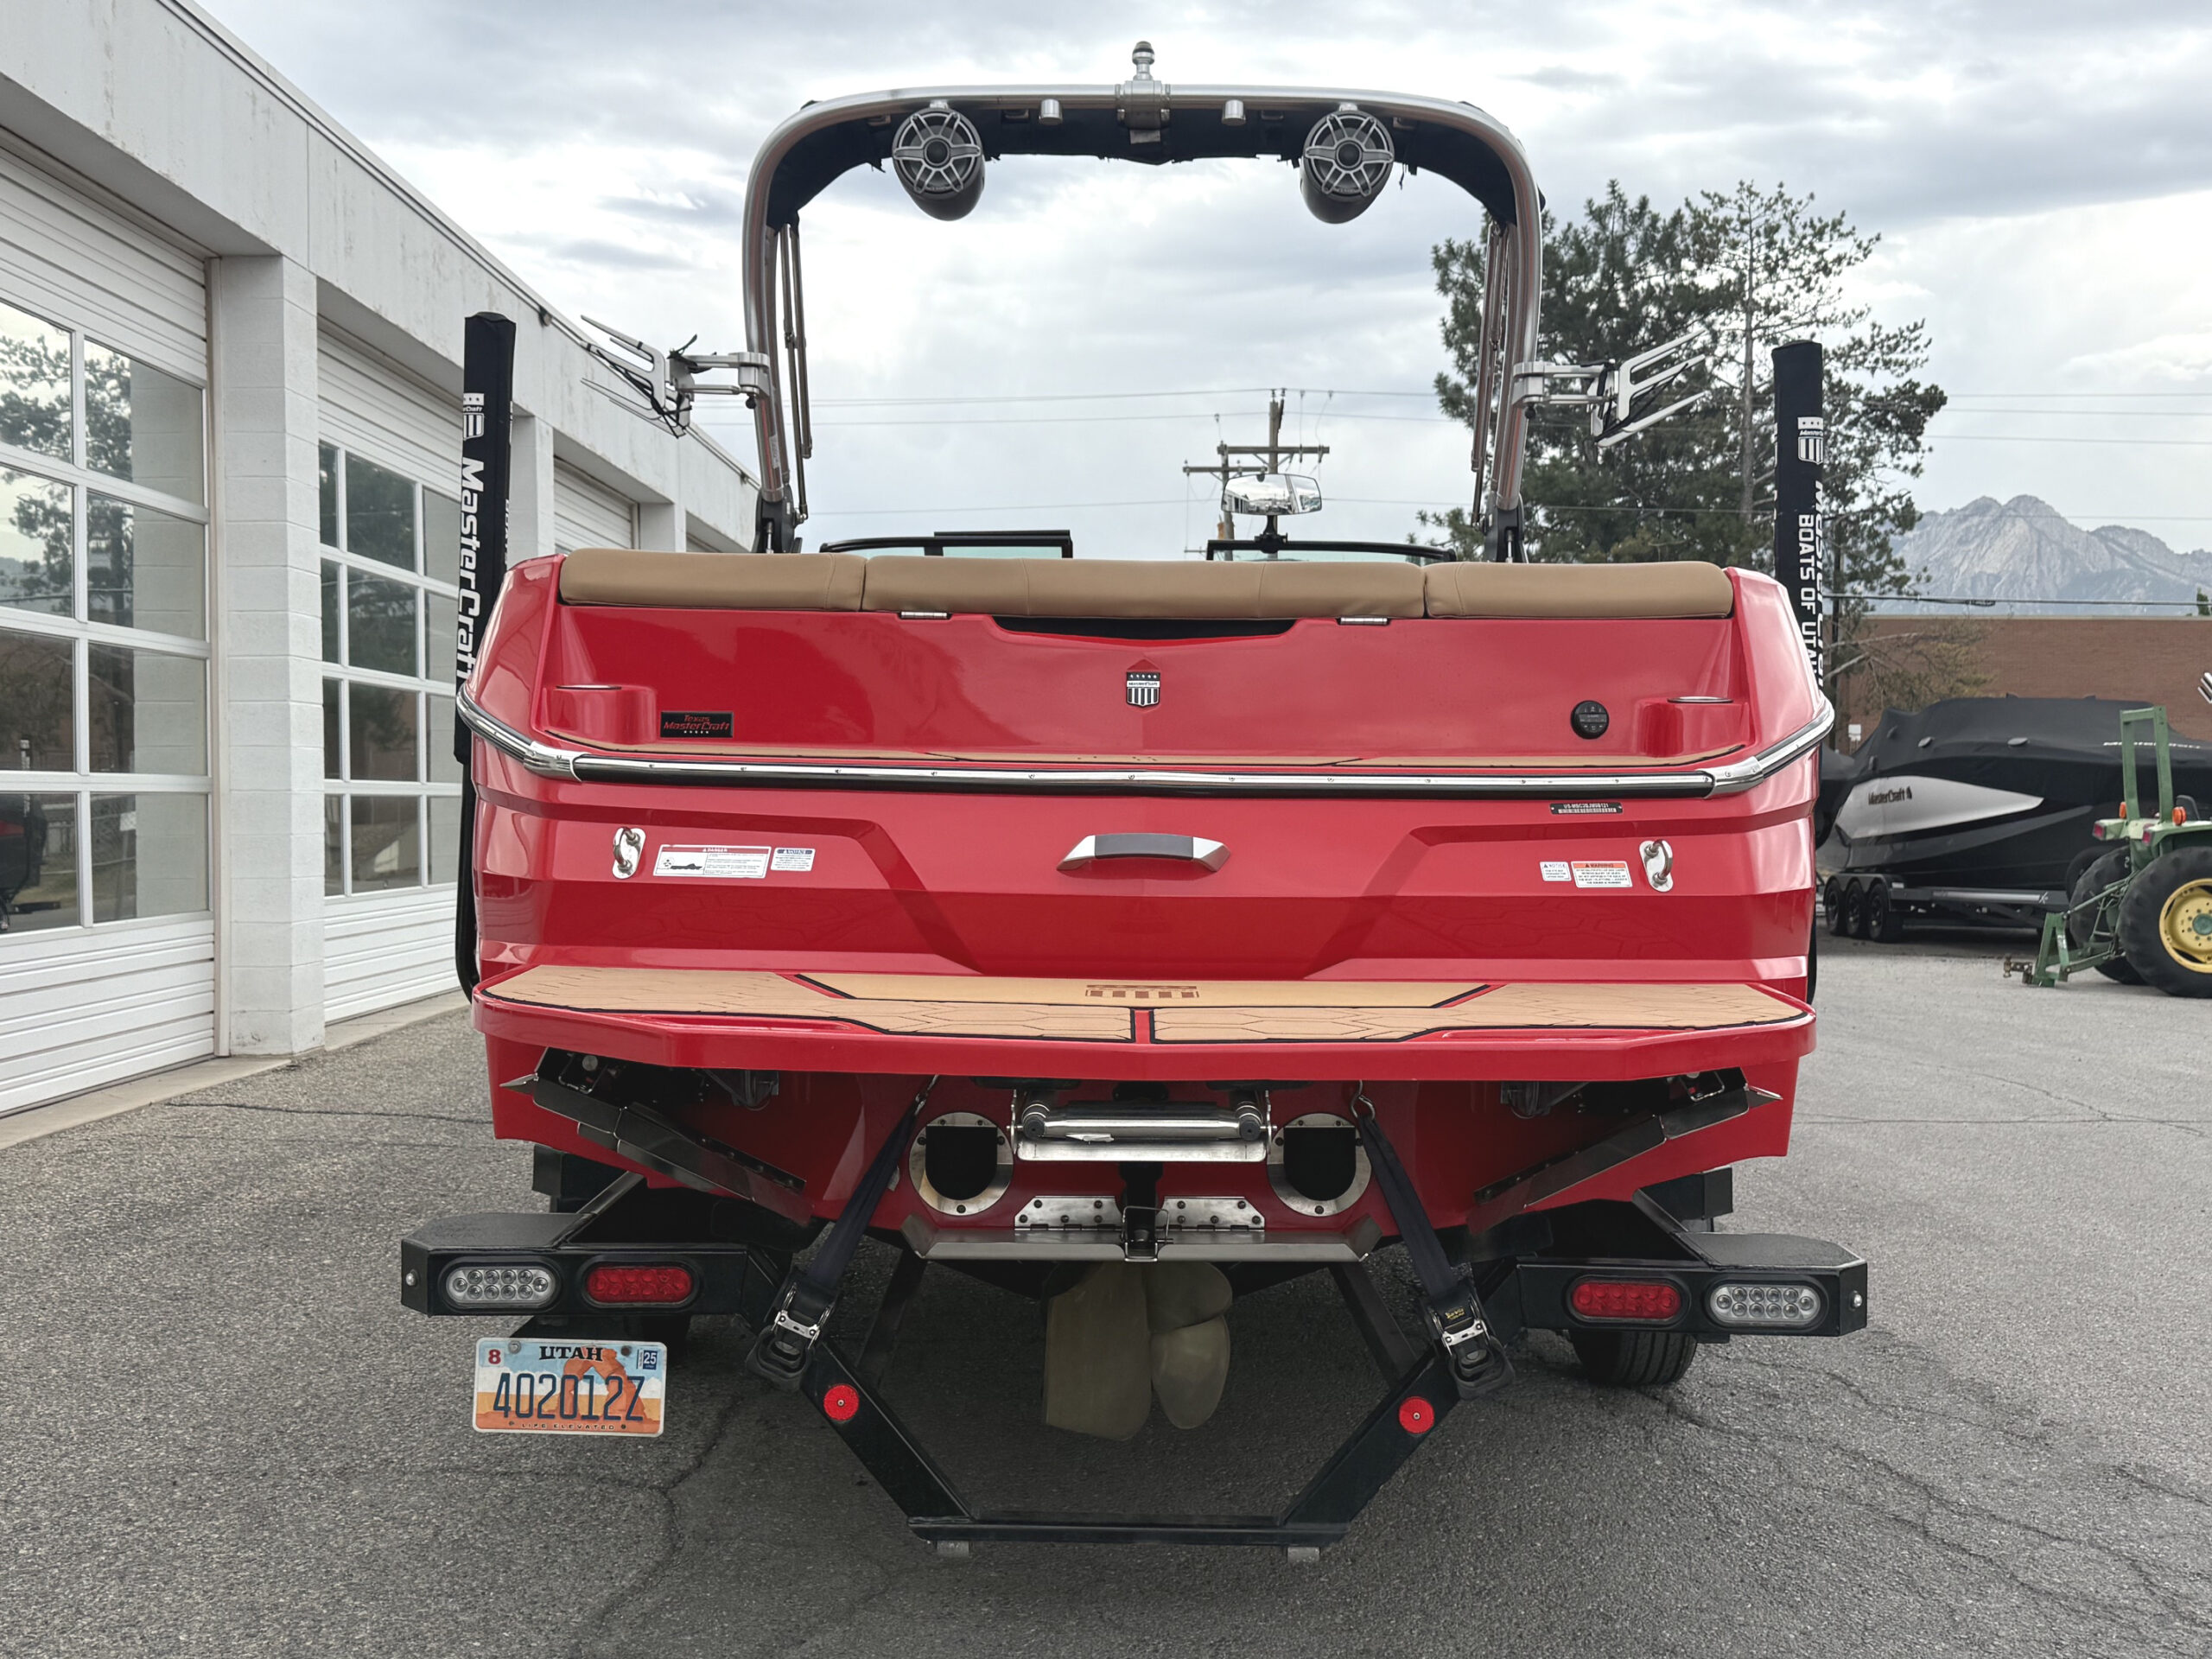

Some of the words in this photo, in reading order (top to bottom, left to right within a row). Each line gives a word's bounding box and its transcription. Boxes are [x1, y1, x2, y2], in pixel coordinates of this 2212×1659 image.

[1799, 514, 1815, 581] BOATS
[456, 456, 484, 679] MasterCraft
[1801, 587, 1816, 615] OF
[1802, 621, 1817, 674] UTA
[664, 721, 730, 731] MasterCraft
[1868, 786, 1905, 805] MasterCraft
[487, 1349, 501, 1365] 8
[538, 1345, 605, 1362] UTAH
[644, 1351, 657, 1365] 25
[493, 1372, 645, 1421] 402012Z
